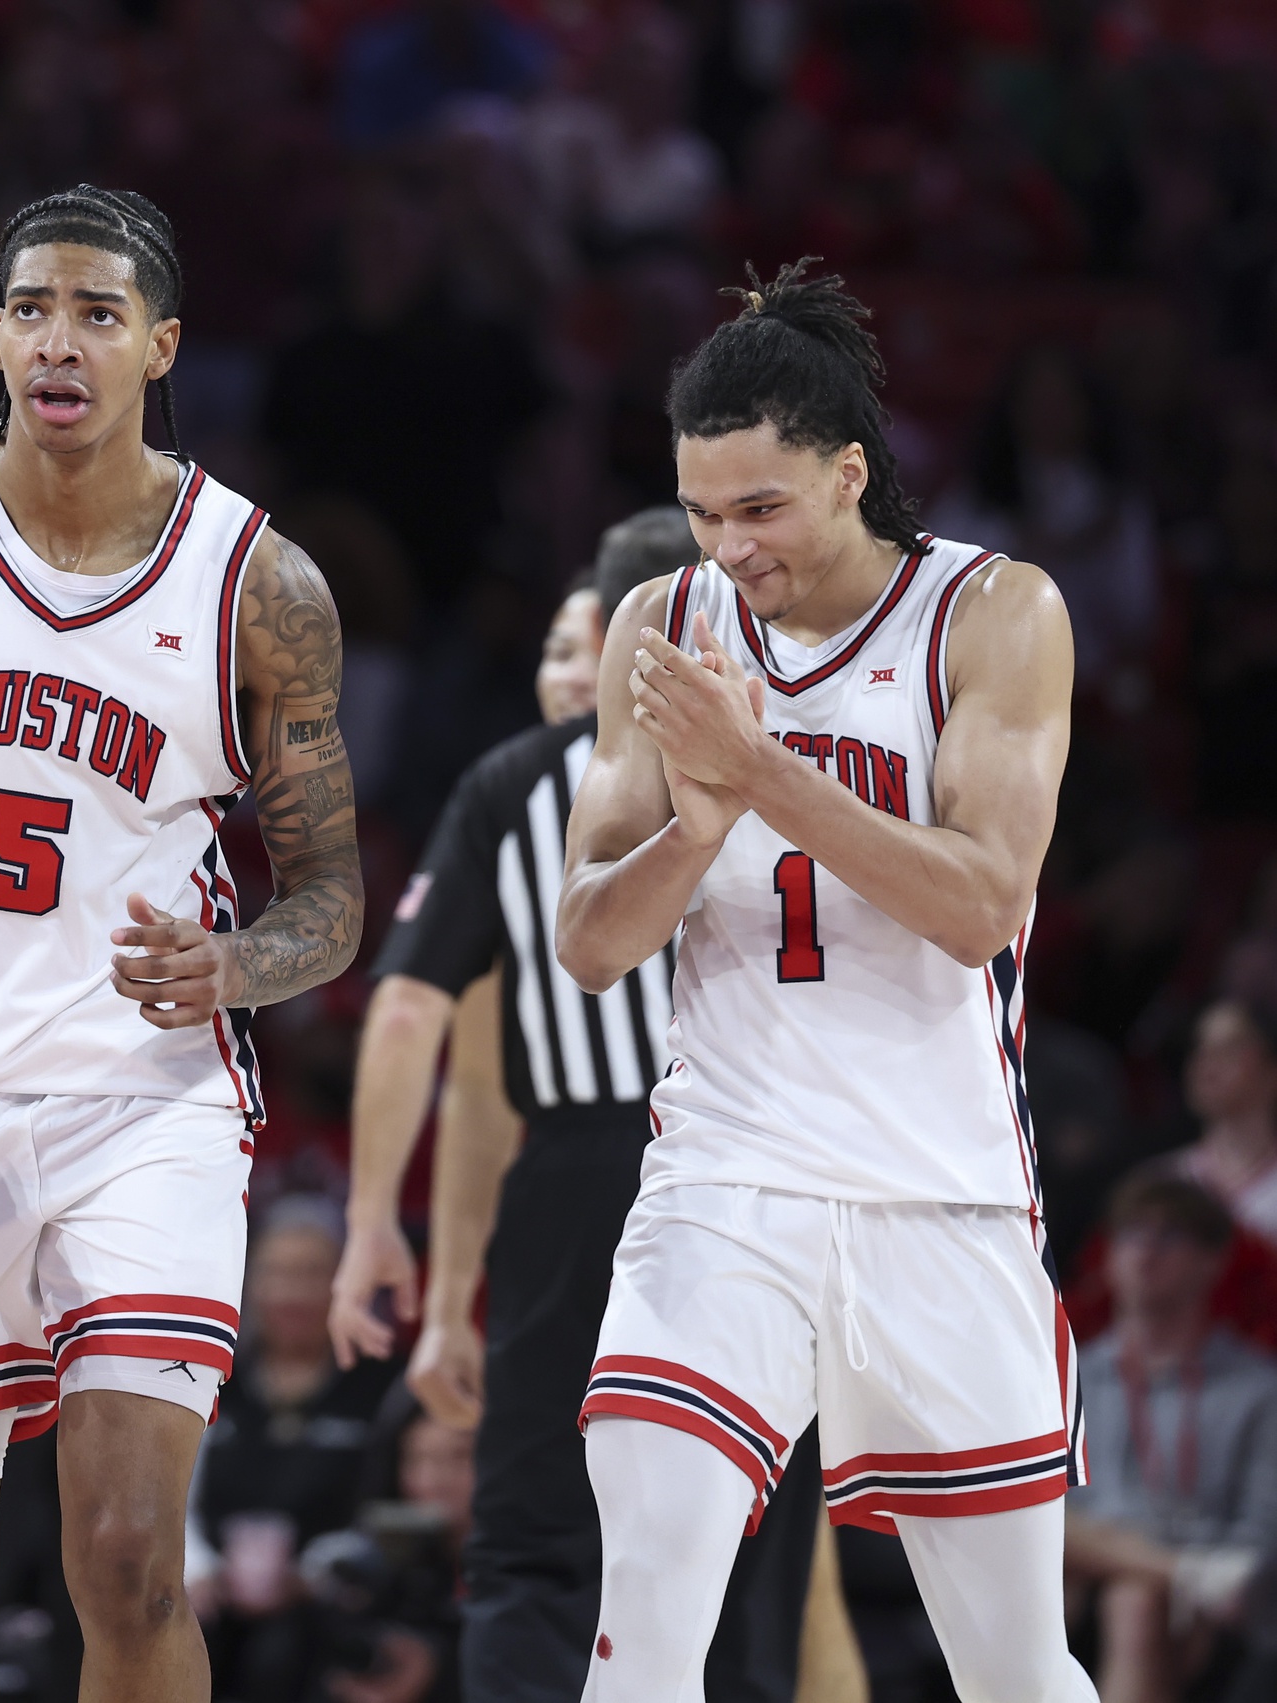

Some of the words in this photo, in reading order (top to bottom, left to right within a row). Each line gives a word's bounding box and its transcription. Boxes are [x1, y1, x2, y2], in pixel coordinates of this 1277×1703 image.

[154, 631, 182, 651] XII
[868, 667, 896, 684] XII
[774, 851, 825, 983] 1
